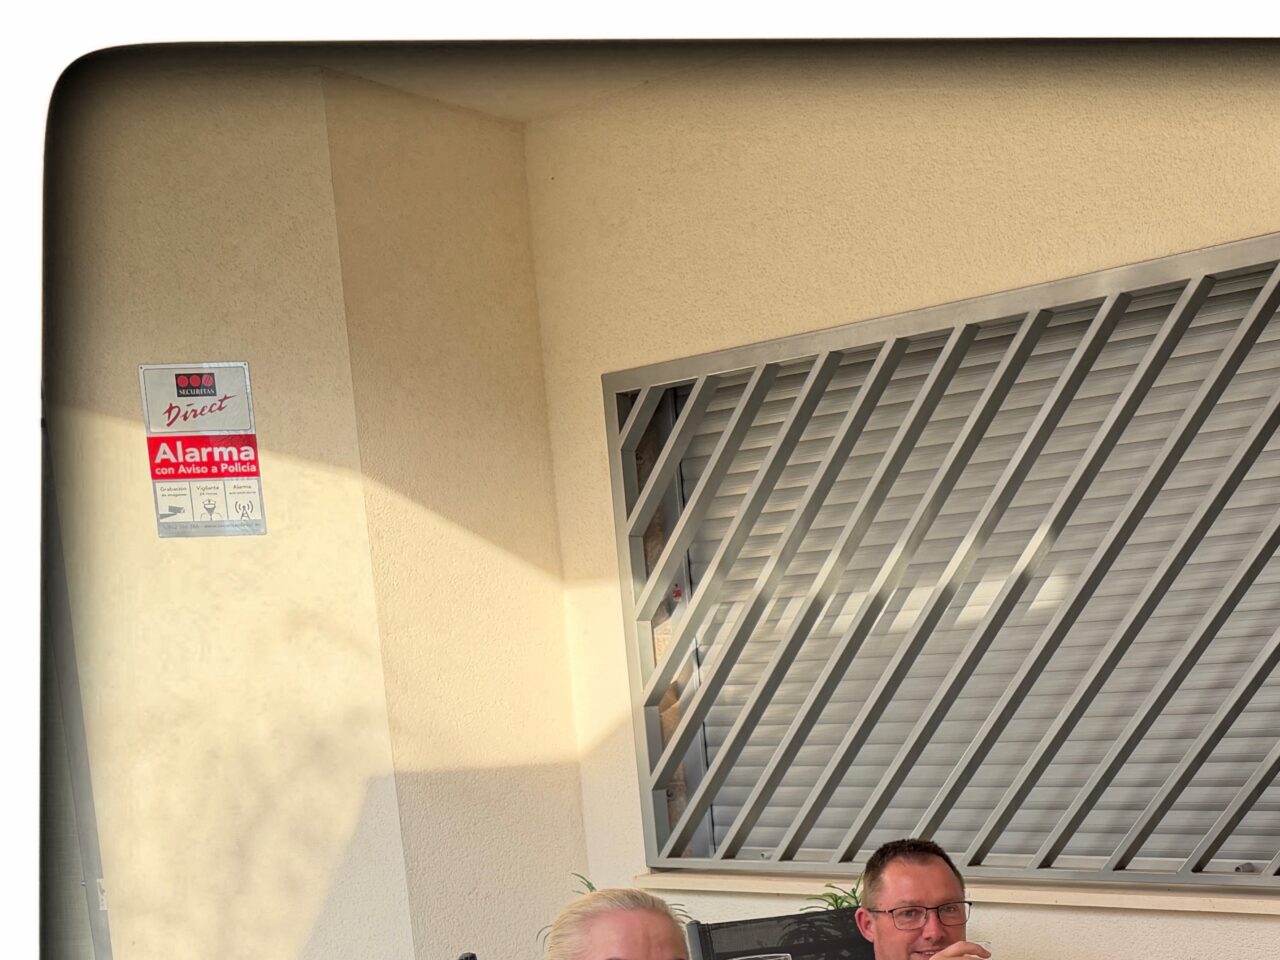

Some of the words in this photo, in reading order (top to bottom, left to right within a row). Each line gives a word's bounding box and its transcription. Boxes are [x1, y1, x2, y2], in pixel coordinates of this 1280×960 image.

[162, 394, 237, 427] Direct
[155, 441, 255, 464] Alarma
[155, 467, 175, 475] con
[178, 463, 208, 474] Aviso
[221, 463, 256, 473] Policía
